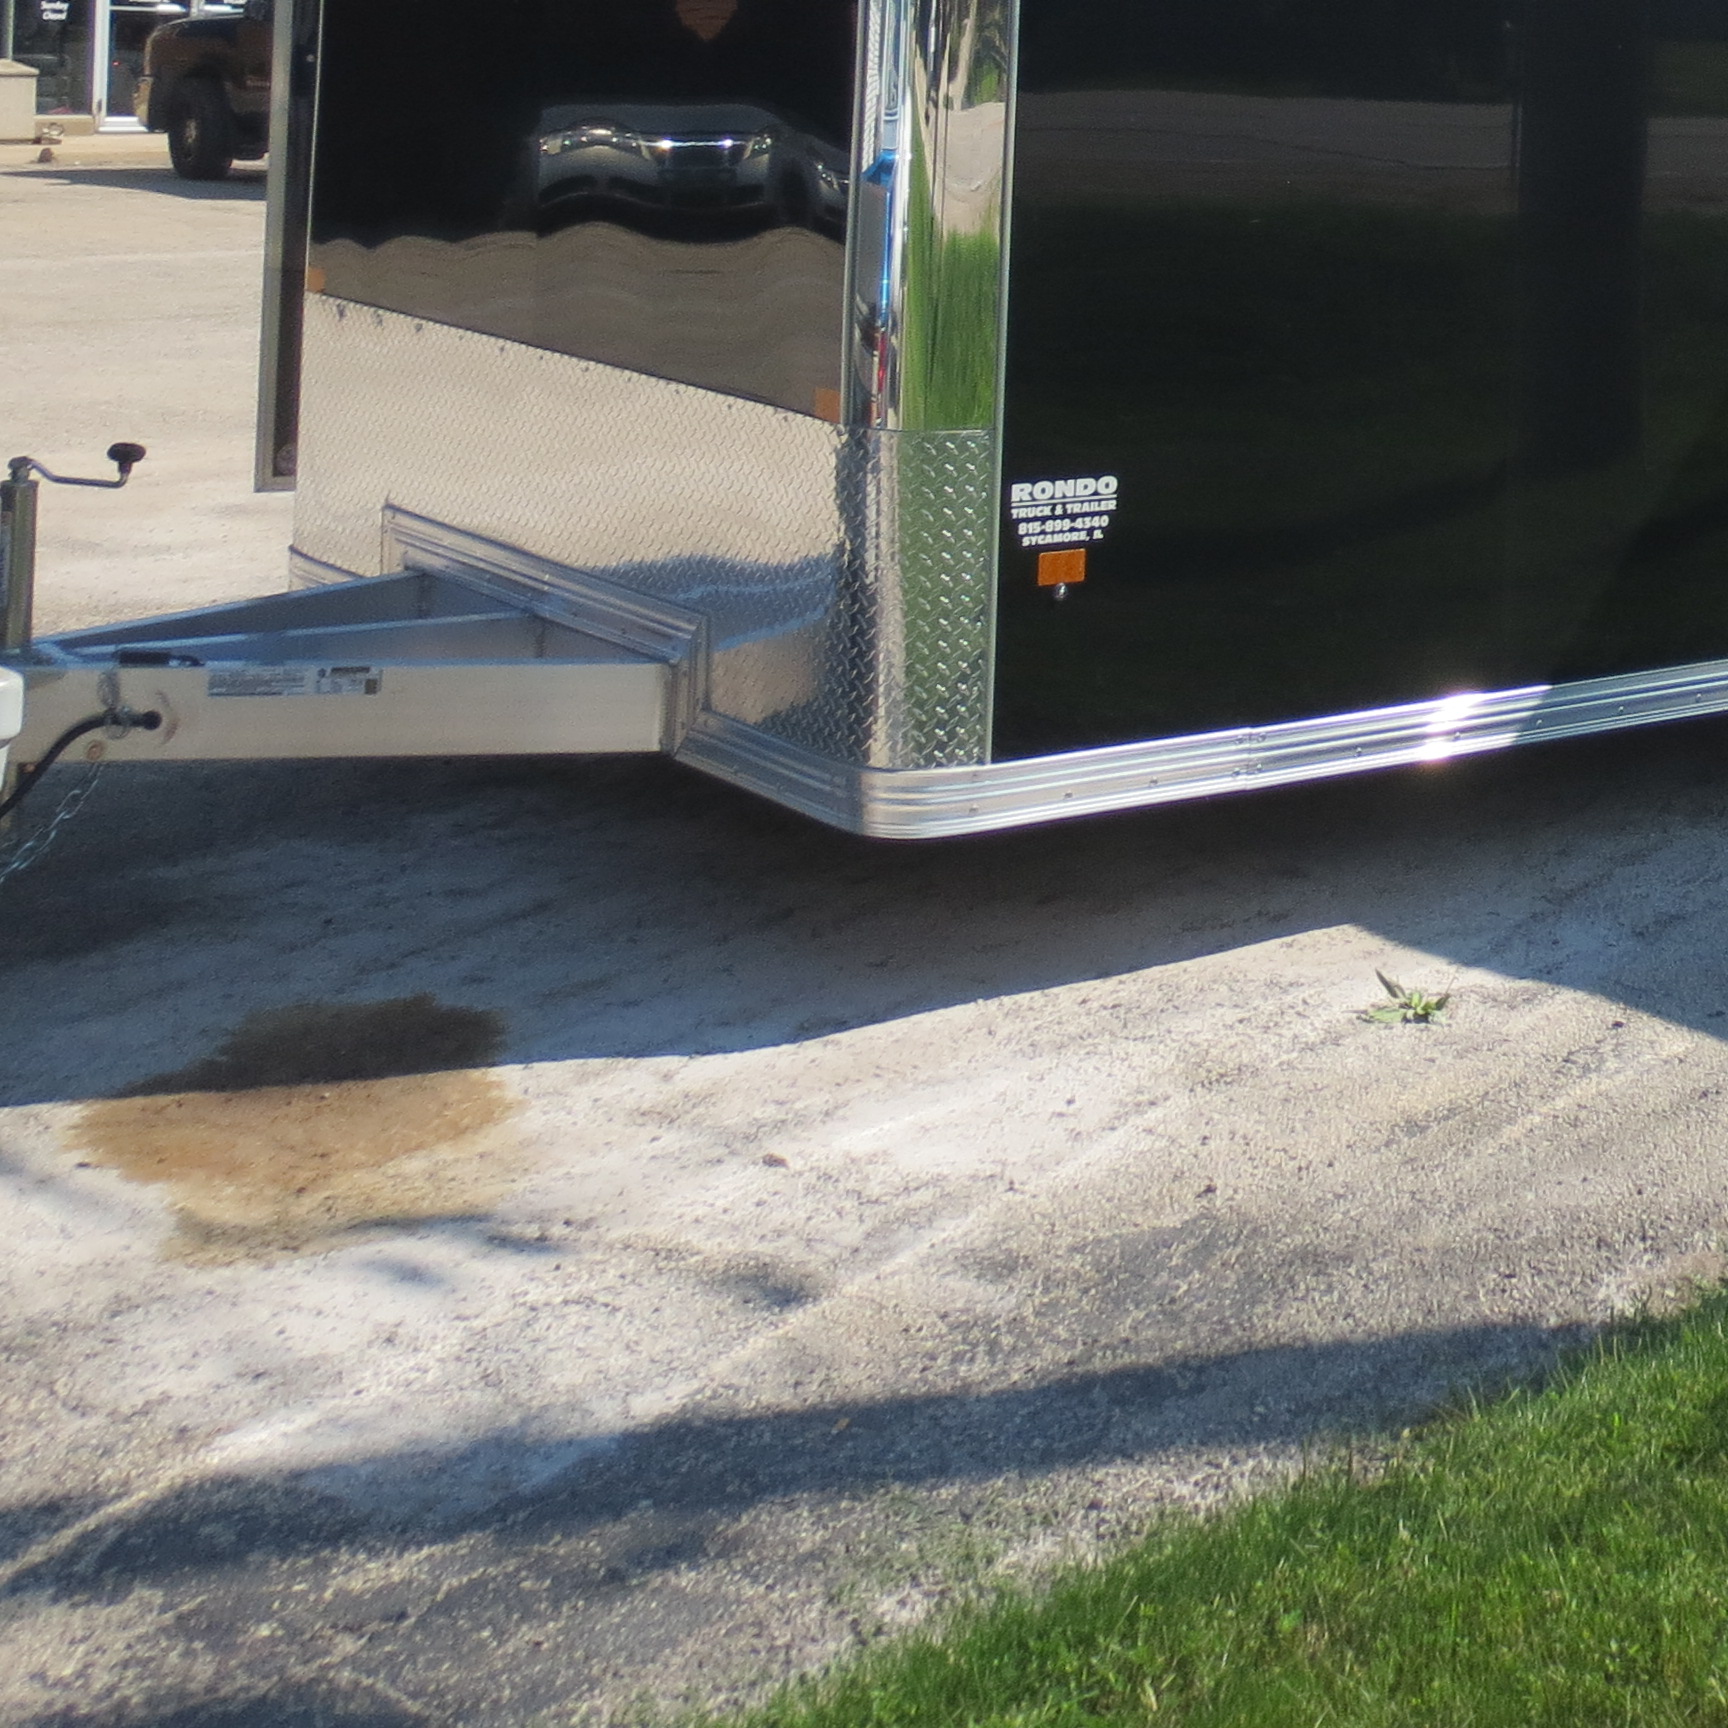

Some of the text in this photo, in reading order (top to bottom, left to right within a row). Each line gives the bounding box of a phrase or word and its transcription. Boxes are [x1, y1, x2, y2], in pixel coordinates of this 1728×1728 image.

[1010, 475, 1118, 502] RONDO
[1010, 499, 1117, 519] TRUCK & TRAILER
[1018, 515, 1110, 535] 815-899-4340
[1022, 530, 1091, 547] SYCAMORE,
